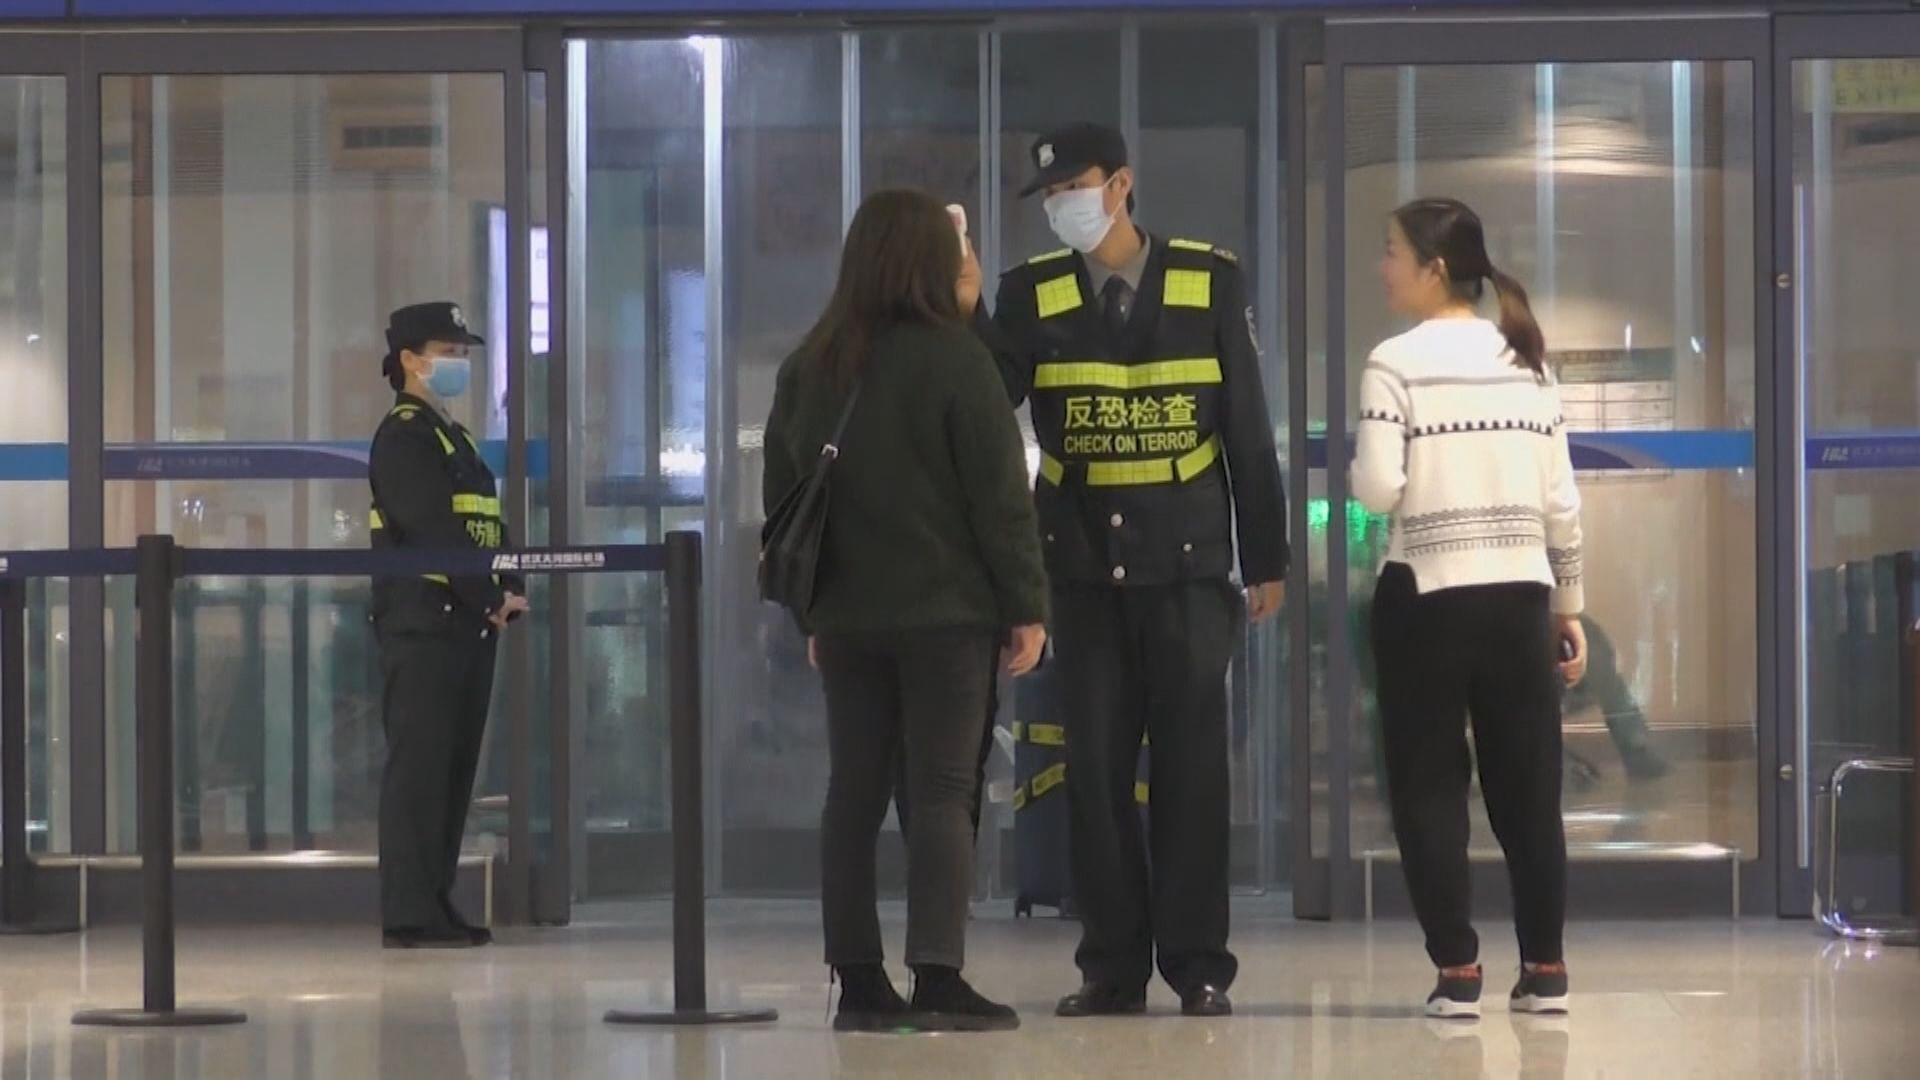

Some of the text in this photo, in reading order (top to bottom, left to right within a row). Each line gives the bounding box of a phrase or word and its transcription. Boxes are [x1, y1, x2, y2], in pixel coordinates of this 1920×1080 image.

[1835, 87, 1900, 105] EXIT
[1064, 393, 1197, 429] 反恐检查
[1063, 430, 1198, 453] CHECK ON TERROR
